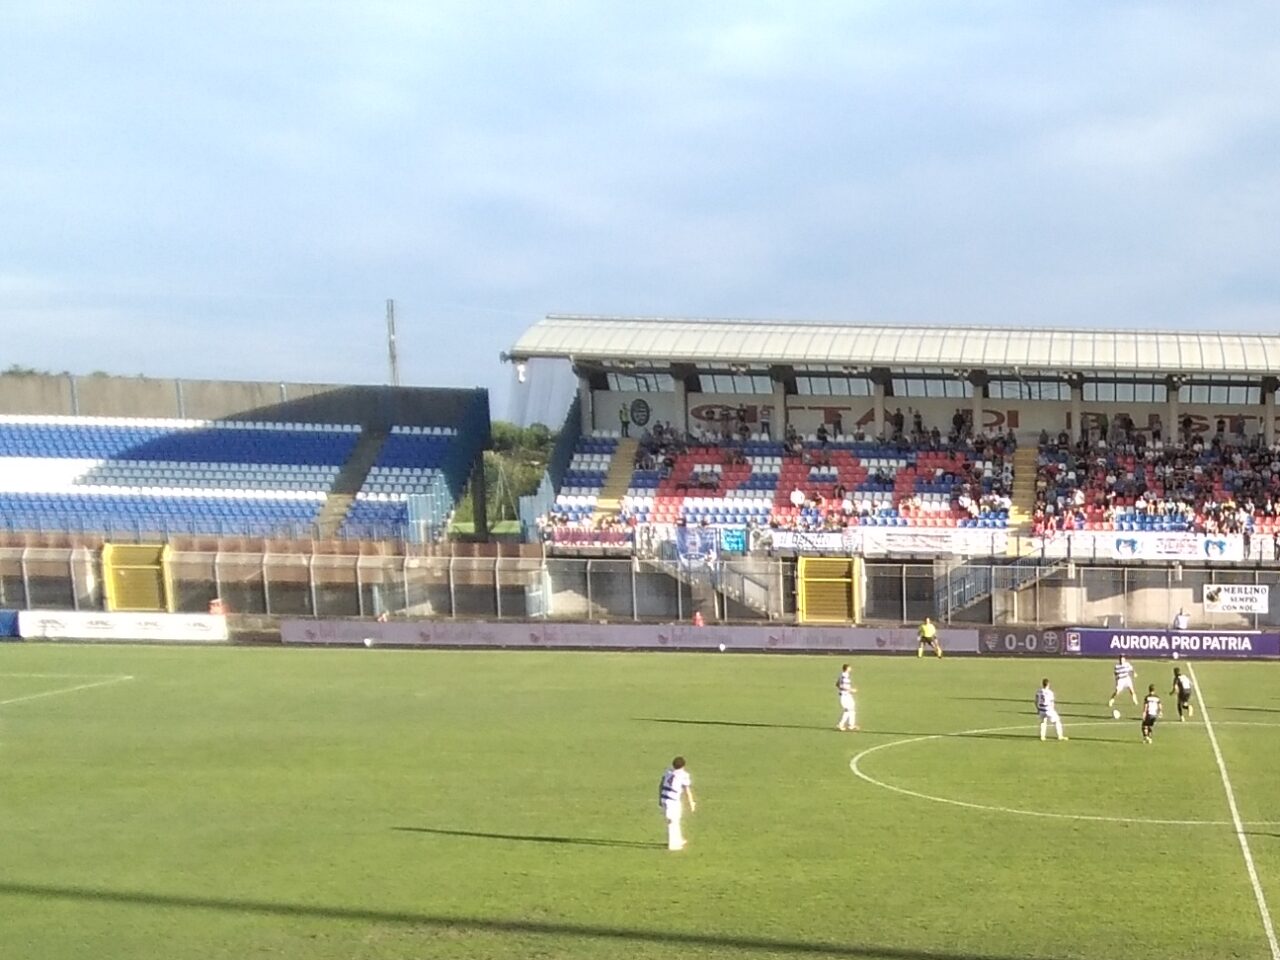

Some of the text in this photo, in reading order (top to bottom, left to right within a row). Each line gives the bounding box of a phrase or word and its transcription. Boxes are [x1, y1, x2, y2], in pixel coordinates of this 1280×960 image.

[1223, 586, 1267, 595] MERLINO
[1004, 634, 1037, 650] 0-0
[1110, 635, 1252, 651] AURORA PRO PATRIA
